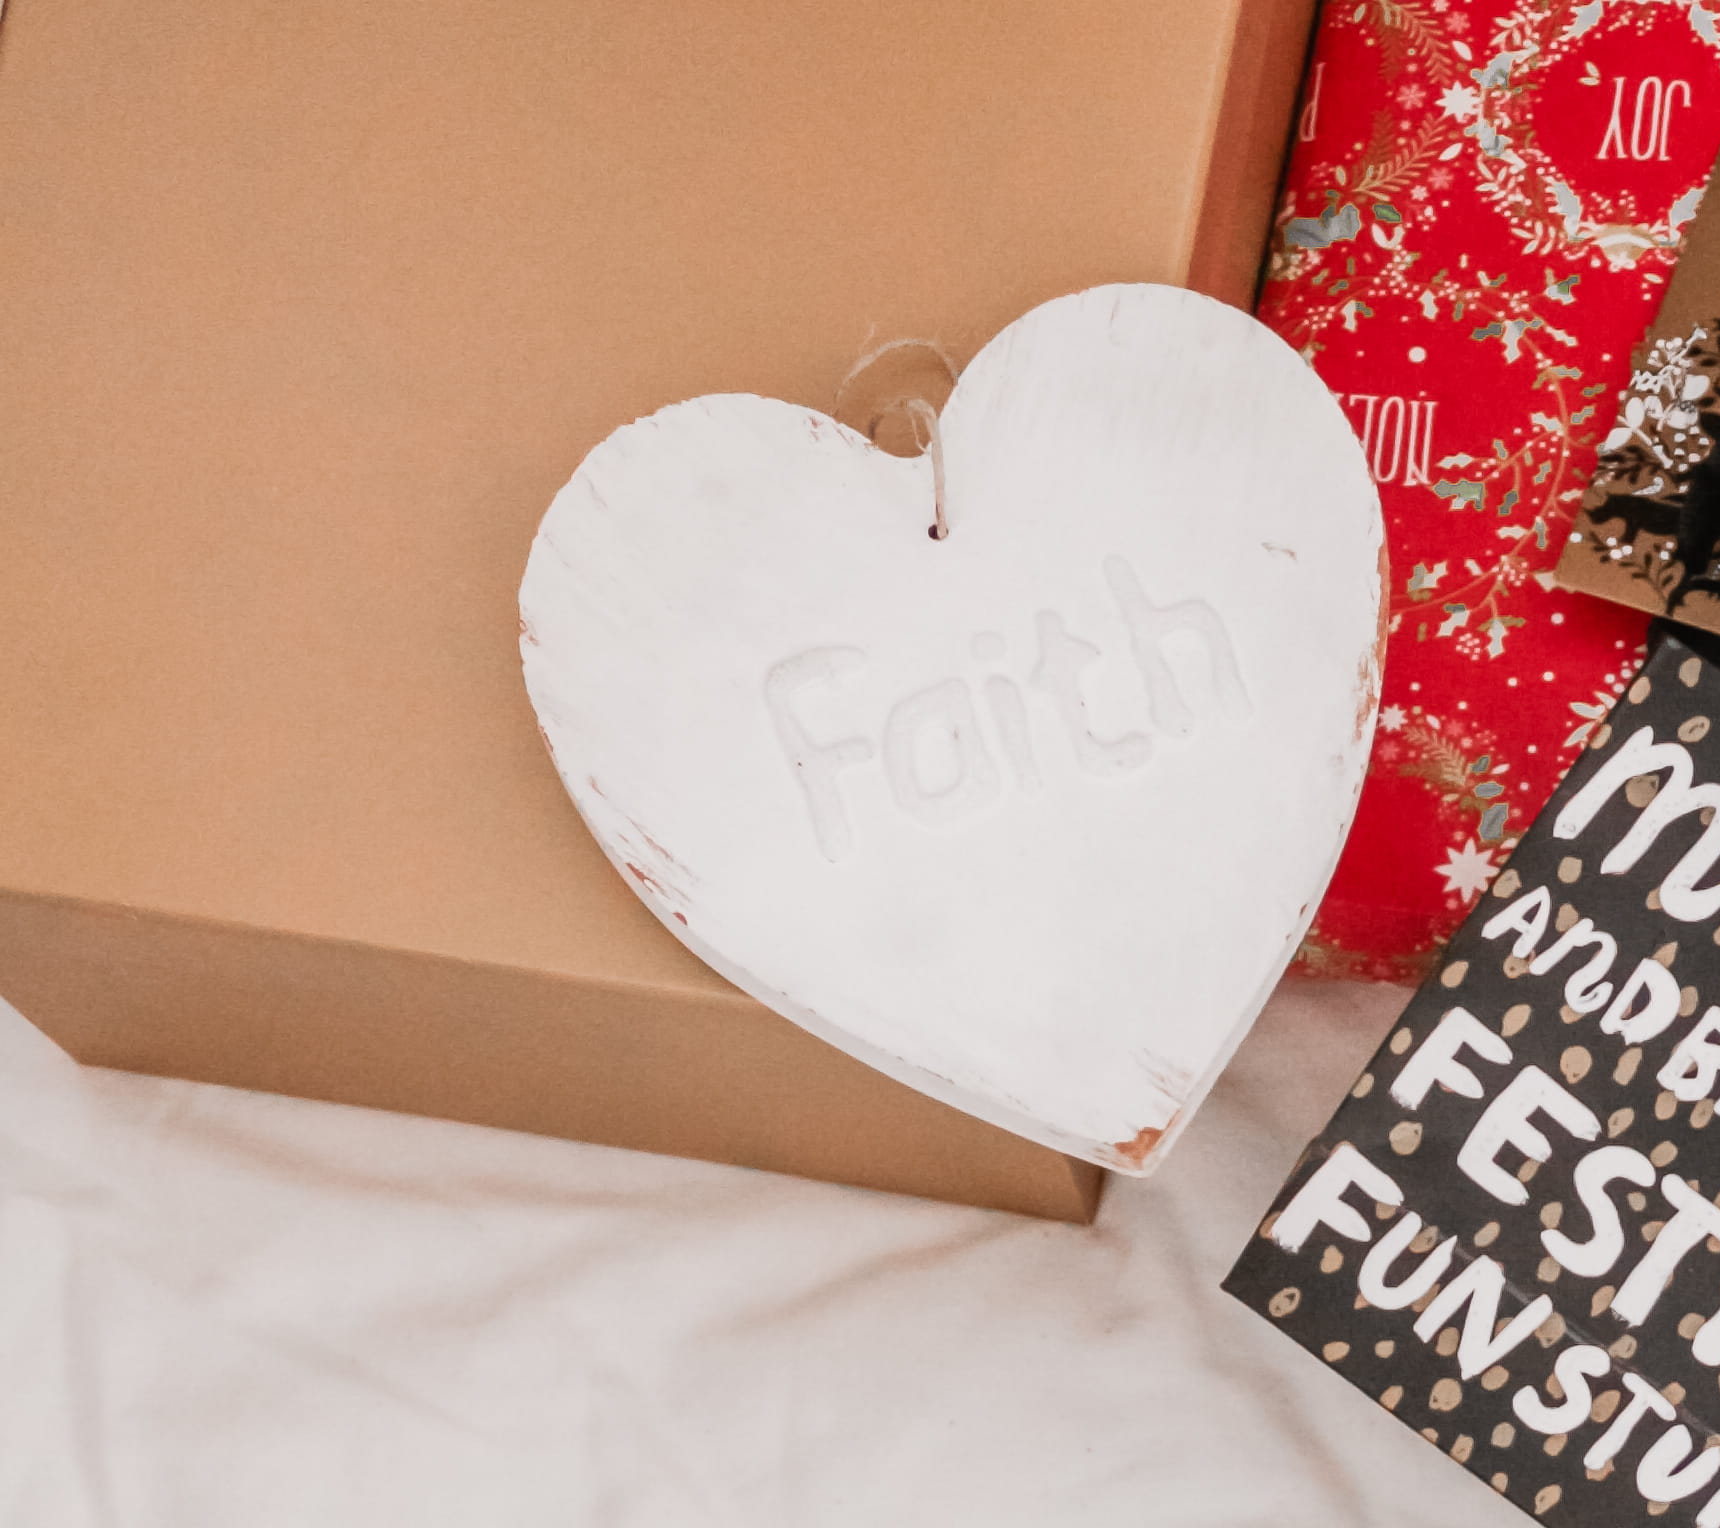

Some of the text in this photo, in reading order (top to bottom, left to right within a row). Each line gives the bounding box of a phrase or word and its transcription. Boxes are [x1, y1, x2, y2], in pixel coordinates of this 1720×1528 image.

[1595, 75, 1692, 162] JOY
[1333, 392, 1438, 486] NOE
[763, 553, 1255, 864] Faith
[1272, 1142, 1553, 1381] FUN
